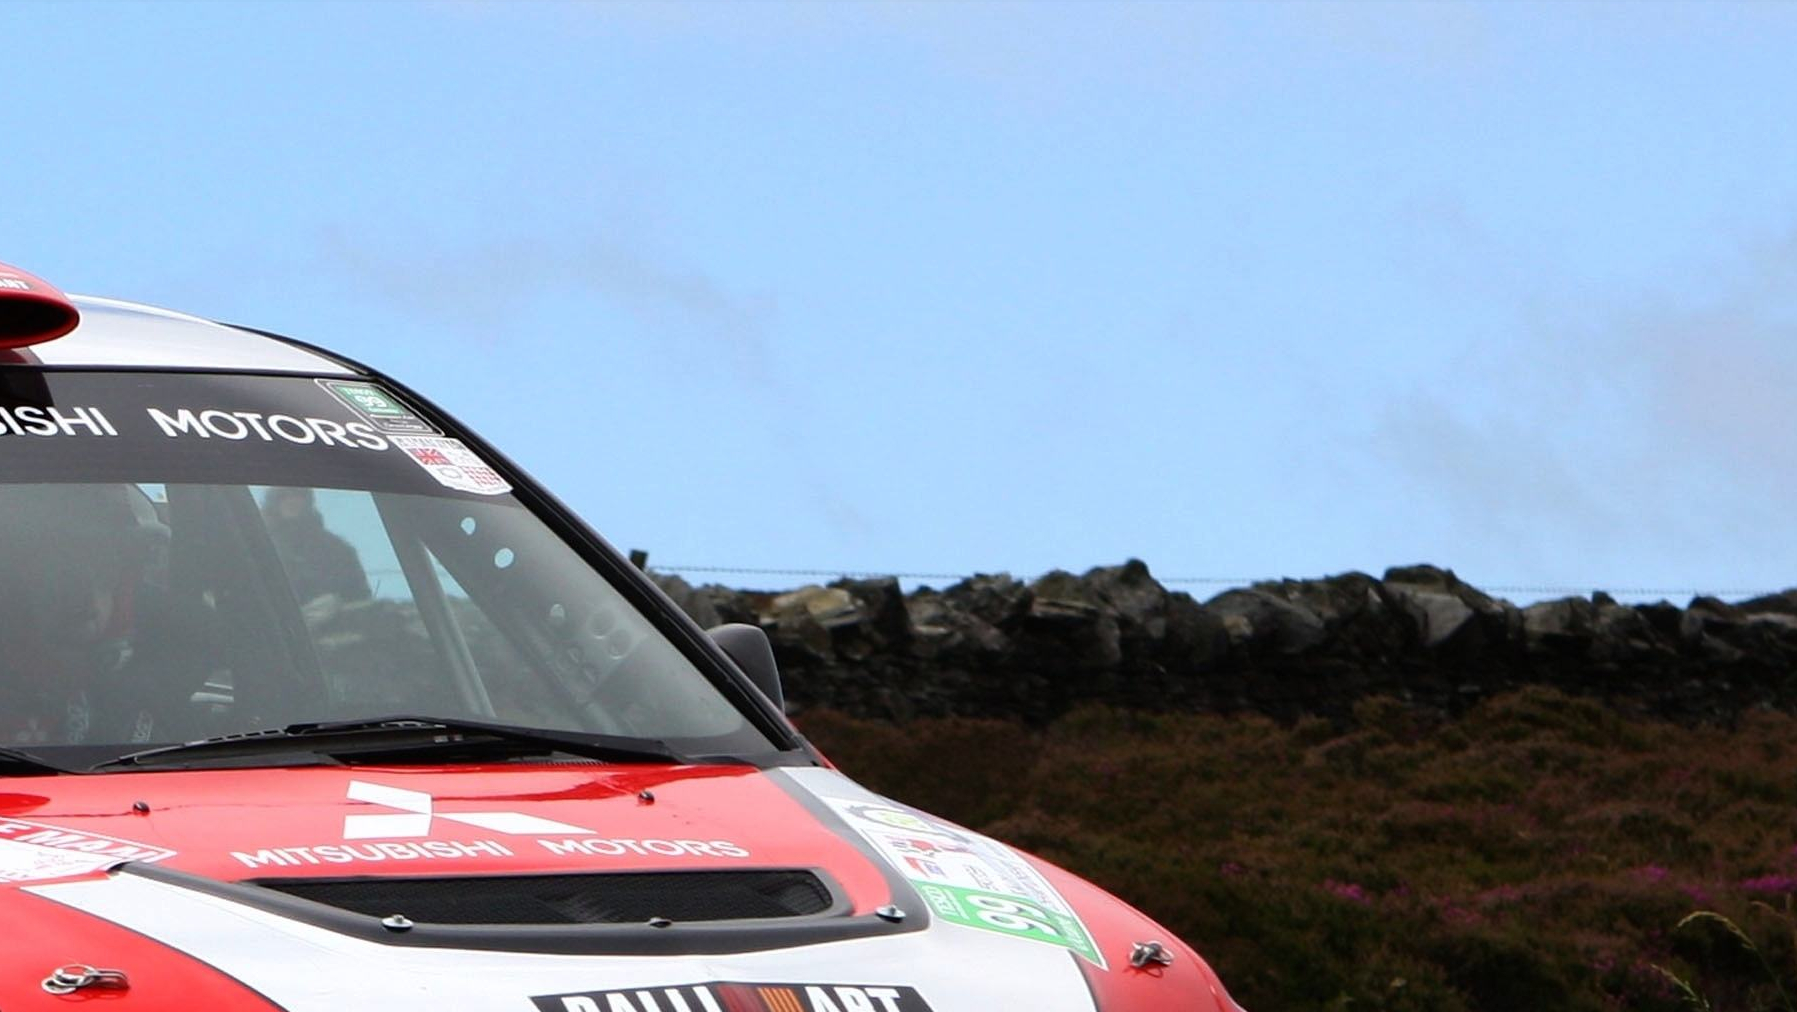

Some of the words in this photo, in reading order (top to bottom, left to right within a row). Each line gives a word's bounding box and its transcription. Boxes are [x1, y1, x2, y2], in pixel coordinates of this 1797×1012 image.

[147, 407, 390, 451] MOTORS
[15, 828, 160, 861] MAN
[230, 839, 514, 868] MITSUBISHI
[537, 838, 750, 859] MOTORS
